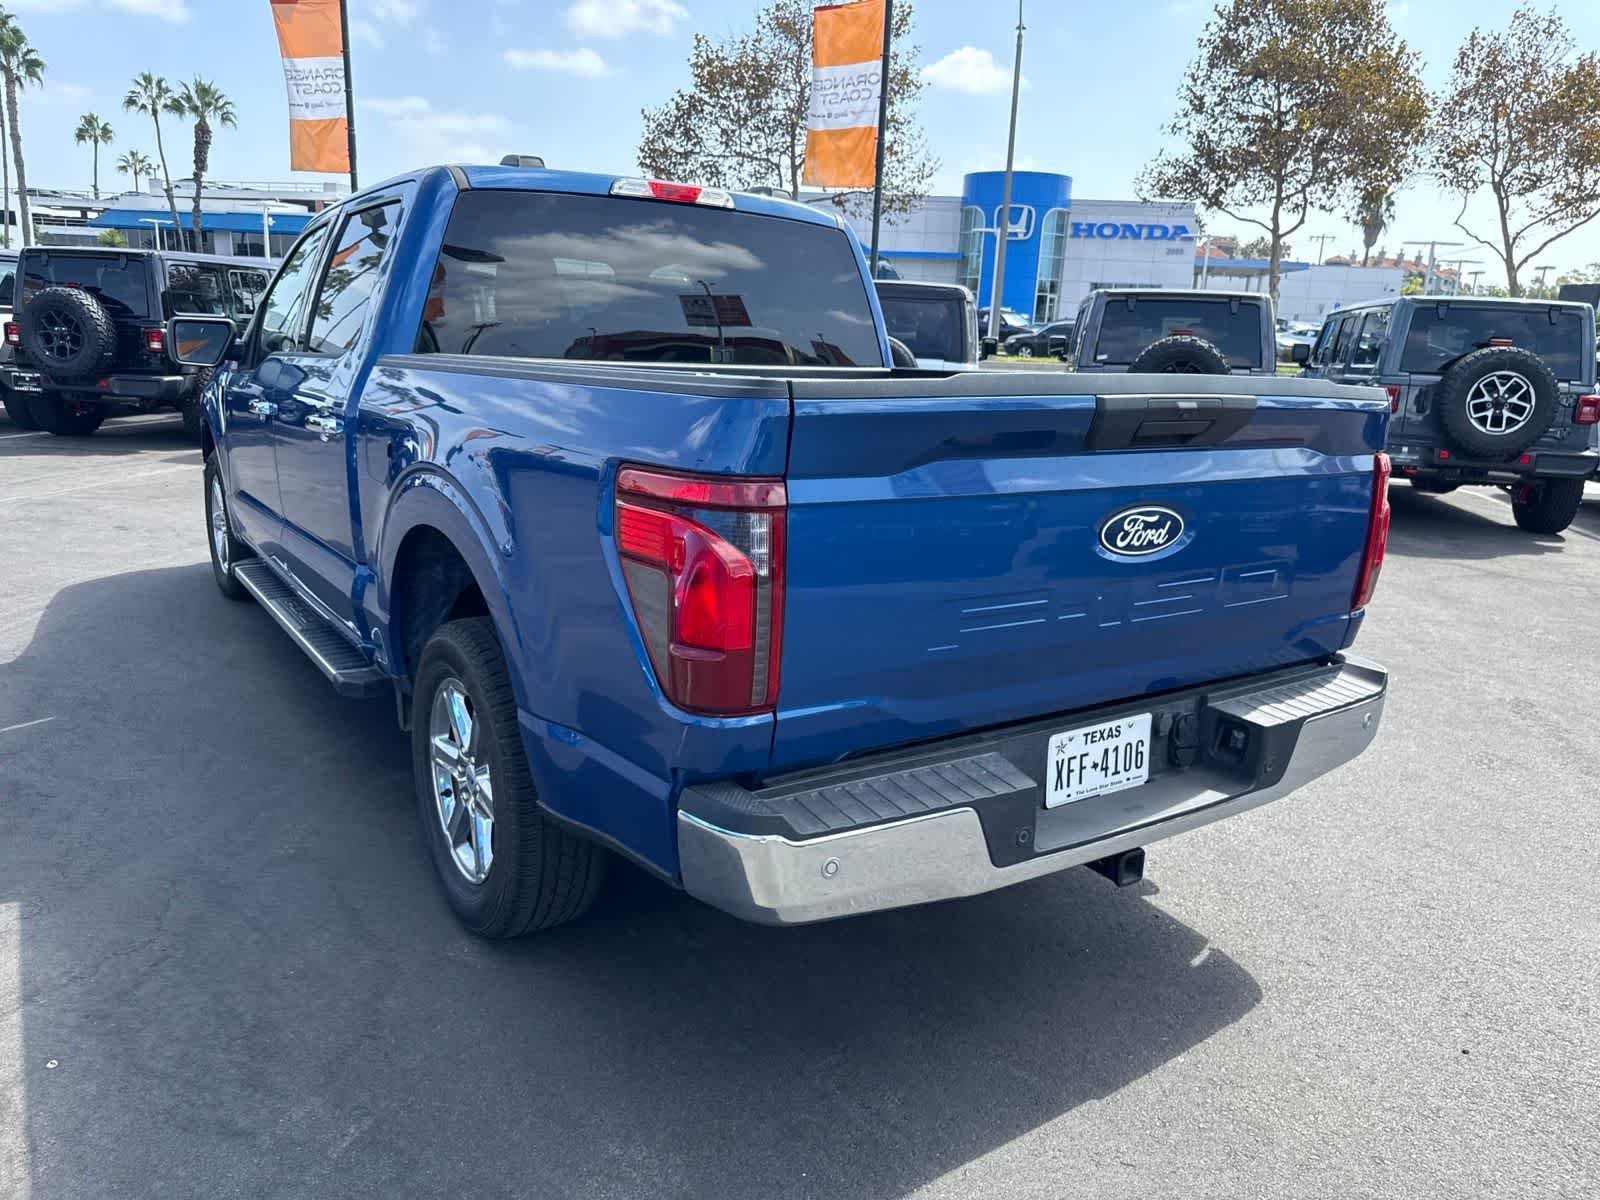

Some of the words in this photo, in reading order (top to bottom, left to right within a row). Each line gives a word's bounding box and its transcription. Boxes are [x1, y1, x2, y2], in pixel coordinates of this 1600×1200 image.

[1070, 222, 1194, 240] HONDA
[1116, 514, 1171, 548] Ford
[1083, 725, 1121, 745] TEXAS
